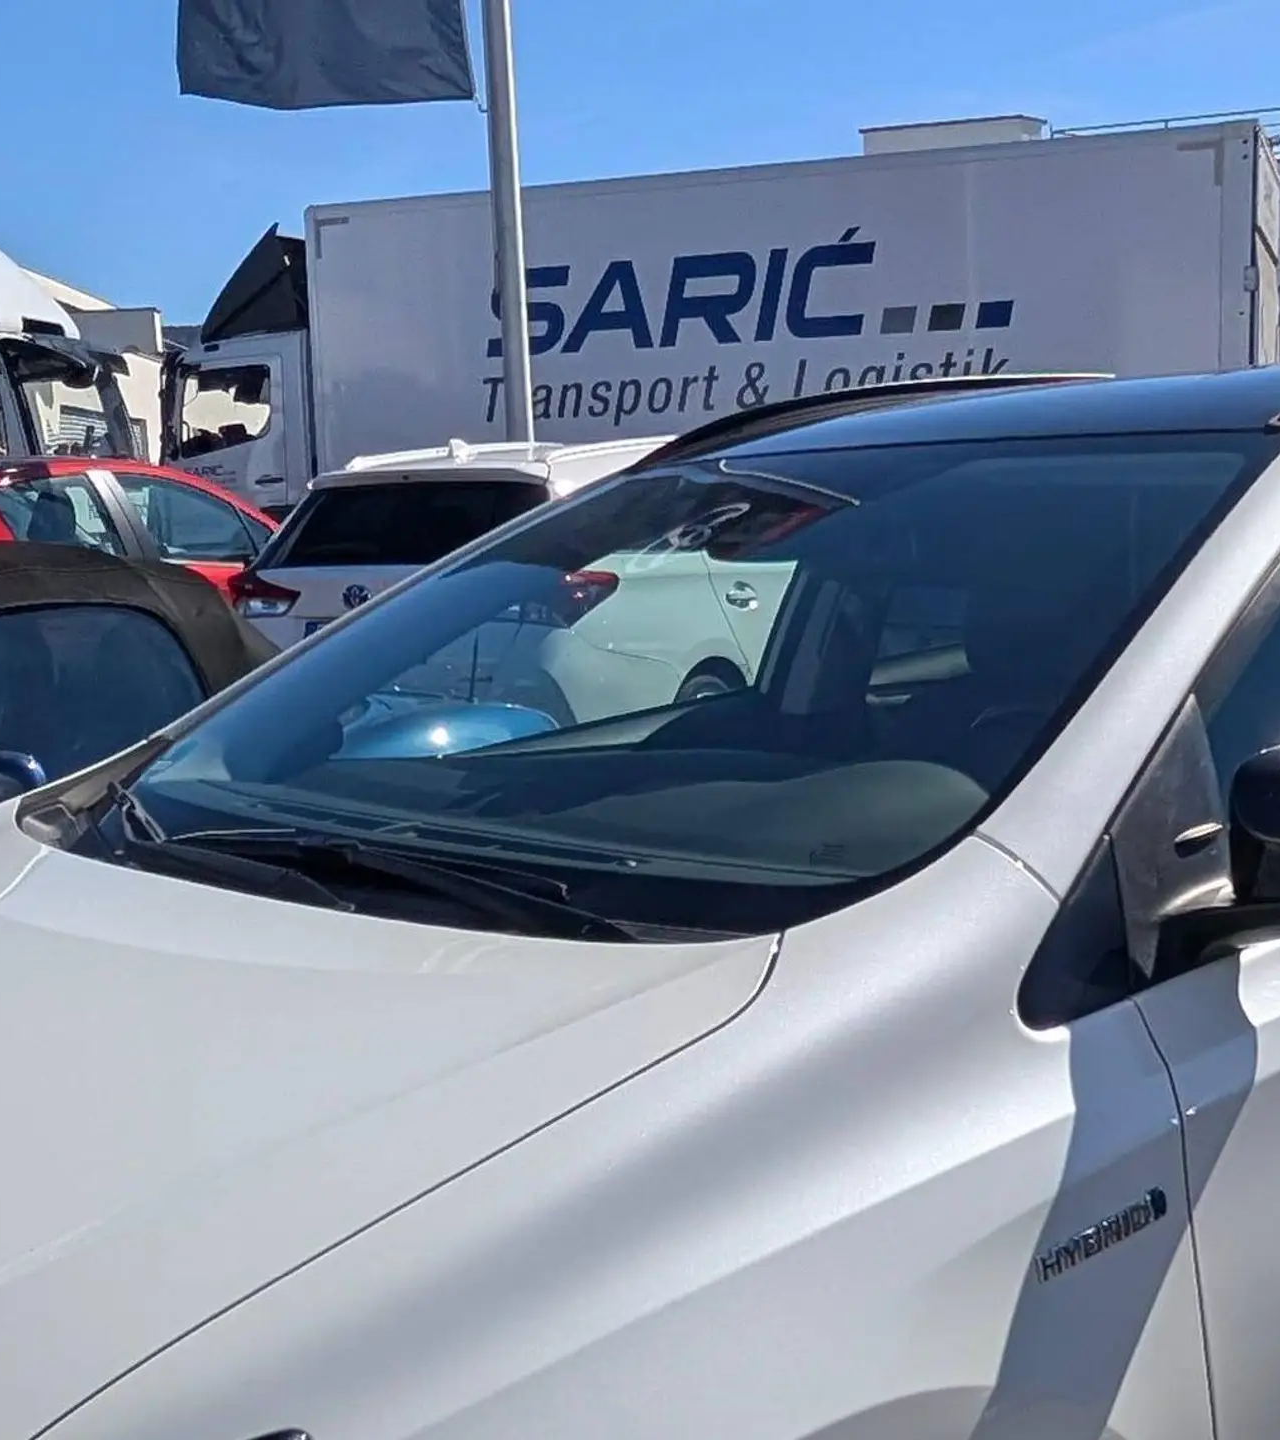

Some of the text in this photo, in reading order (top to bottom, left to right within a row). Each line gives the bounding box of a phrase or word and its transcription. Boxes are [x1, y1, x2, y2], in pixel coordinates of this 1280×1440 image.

[486, 226, 876, 358] SARIĆ
[483, 364, 719, 426] Tansport
[735, 362, 770, 408] &
[1035, 1201, 1152, 1284] HYBRID
